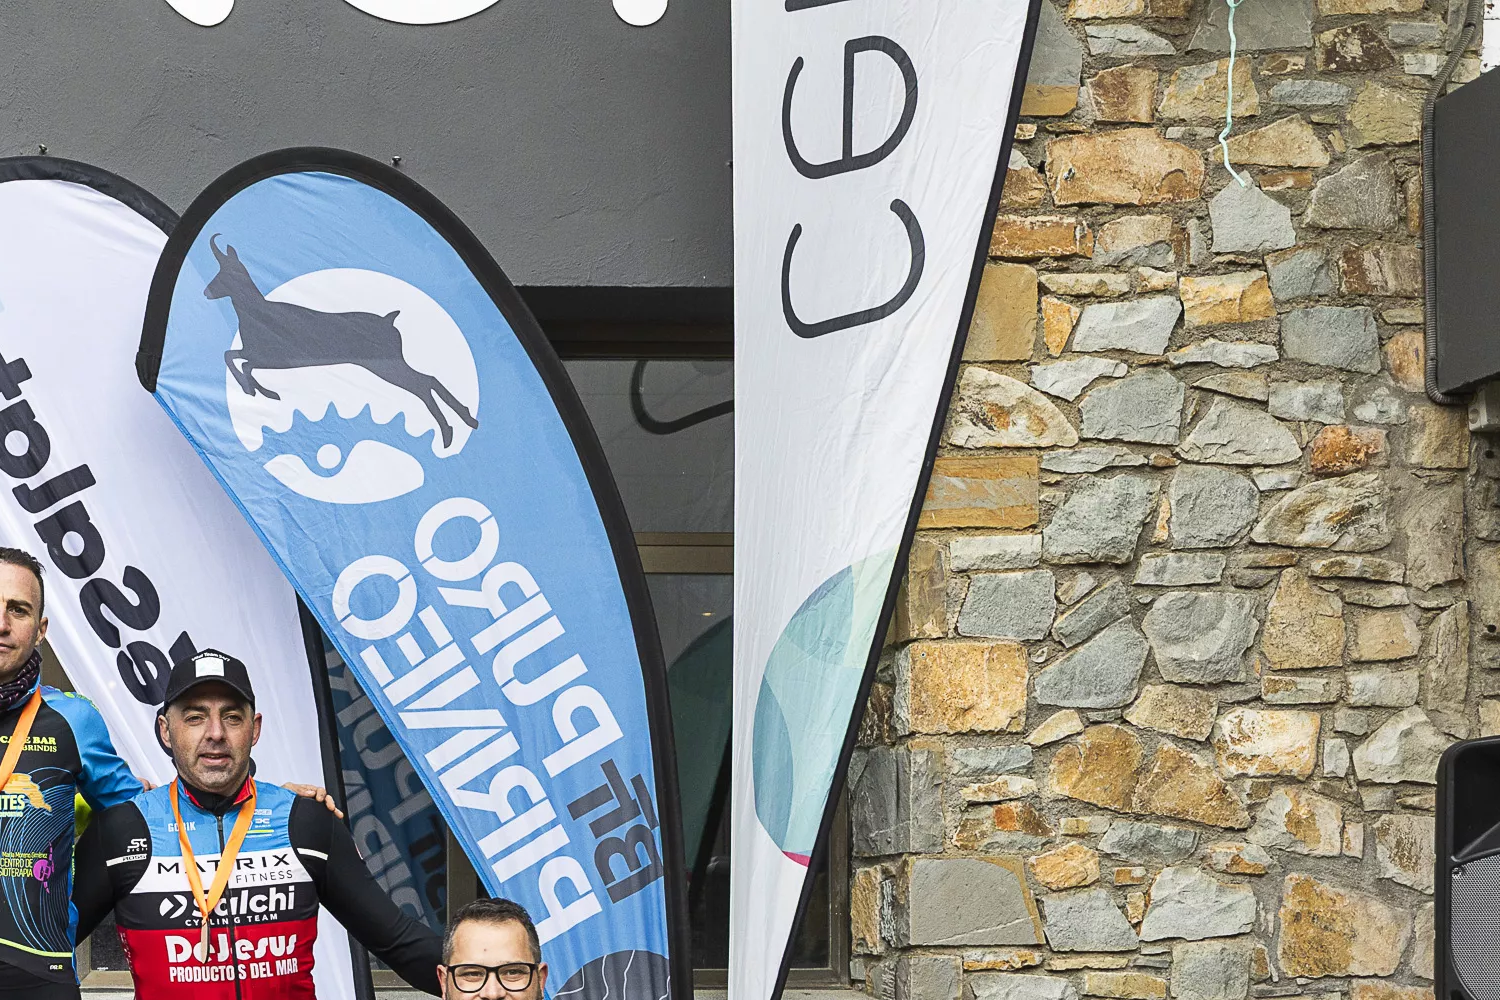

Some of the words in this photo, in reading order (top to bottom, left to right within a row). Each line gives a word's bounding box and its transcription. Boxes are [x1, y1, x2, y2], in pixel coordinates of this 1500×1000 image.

[32, 736, 57, 745] BAR
[0, 858, 25, 868] CENTRO
[25, 859, 34, 868] DE
[235, 869, 294, 884] FITNESS
[246, 912, 279, 923] TEAM
[169, 963, 248, 983] PRODUCTOS
[250, 961, 274, 979] DEL
[275, 957, 299, 976] MAR
